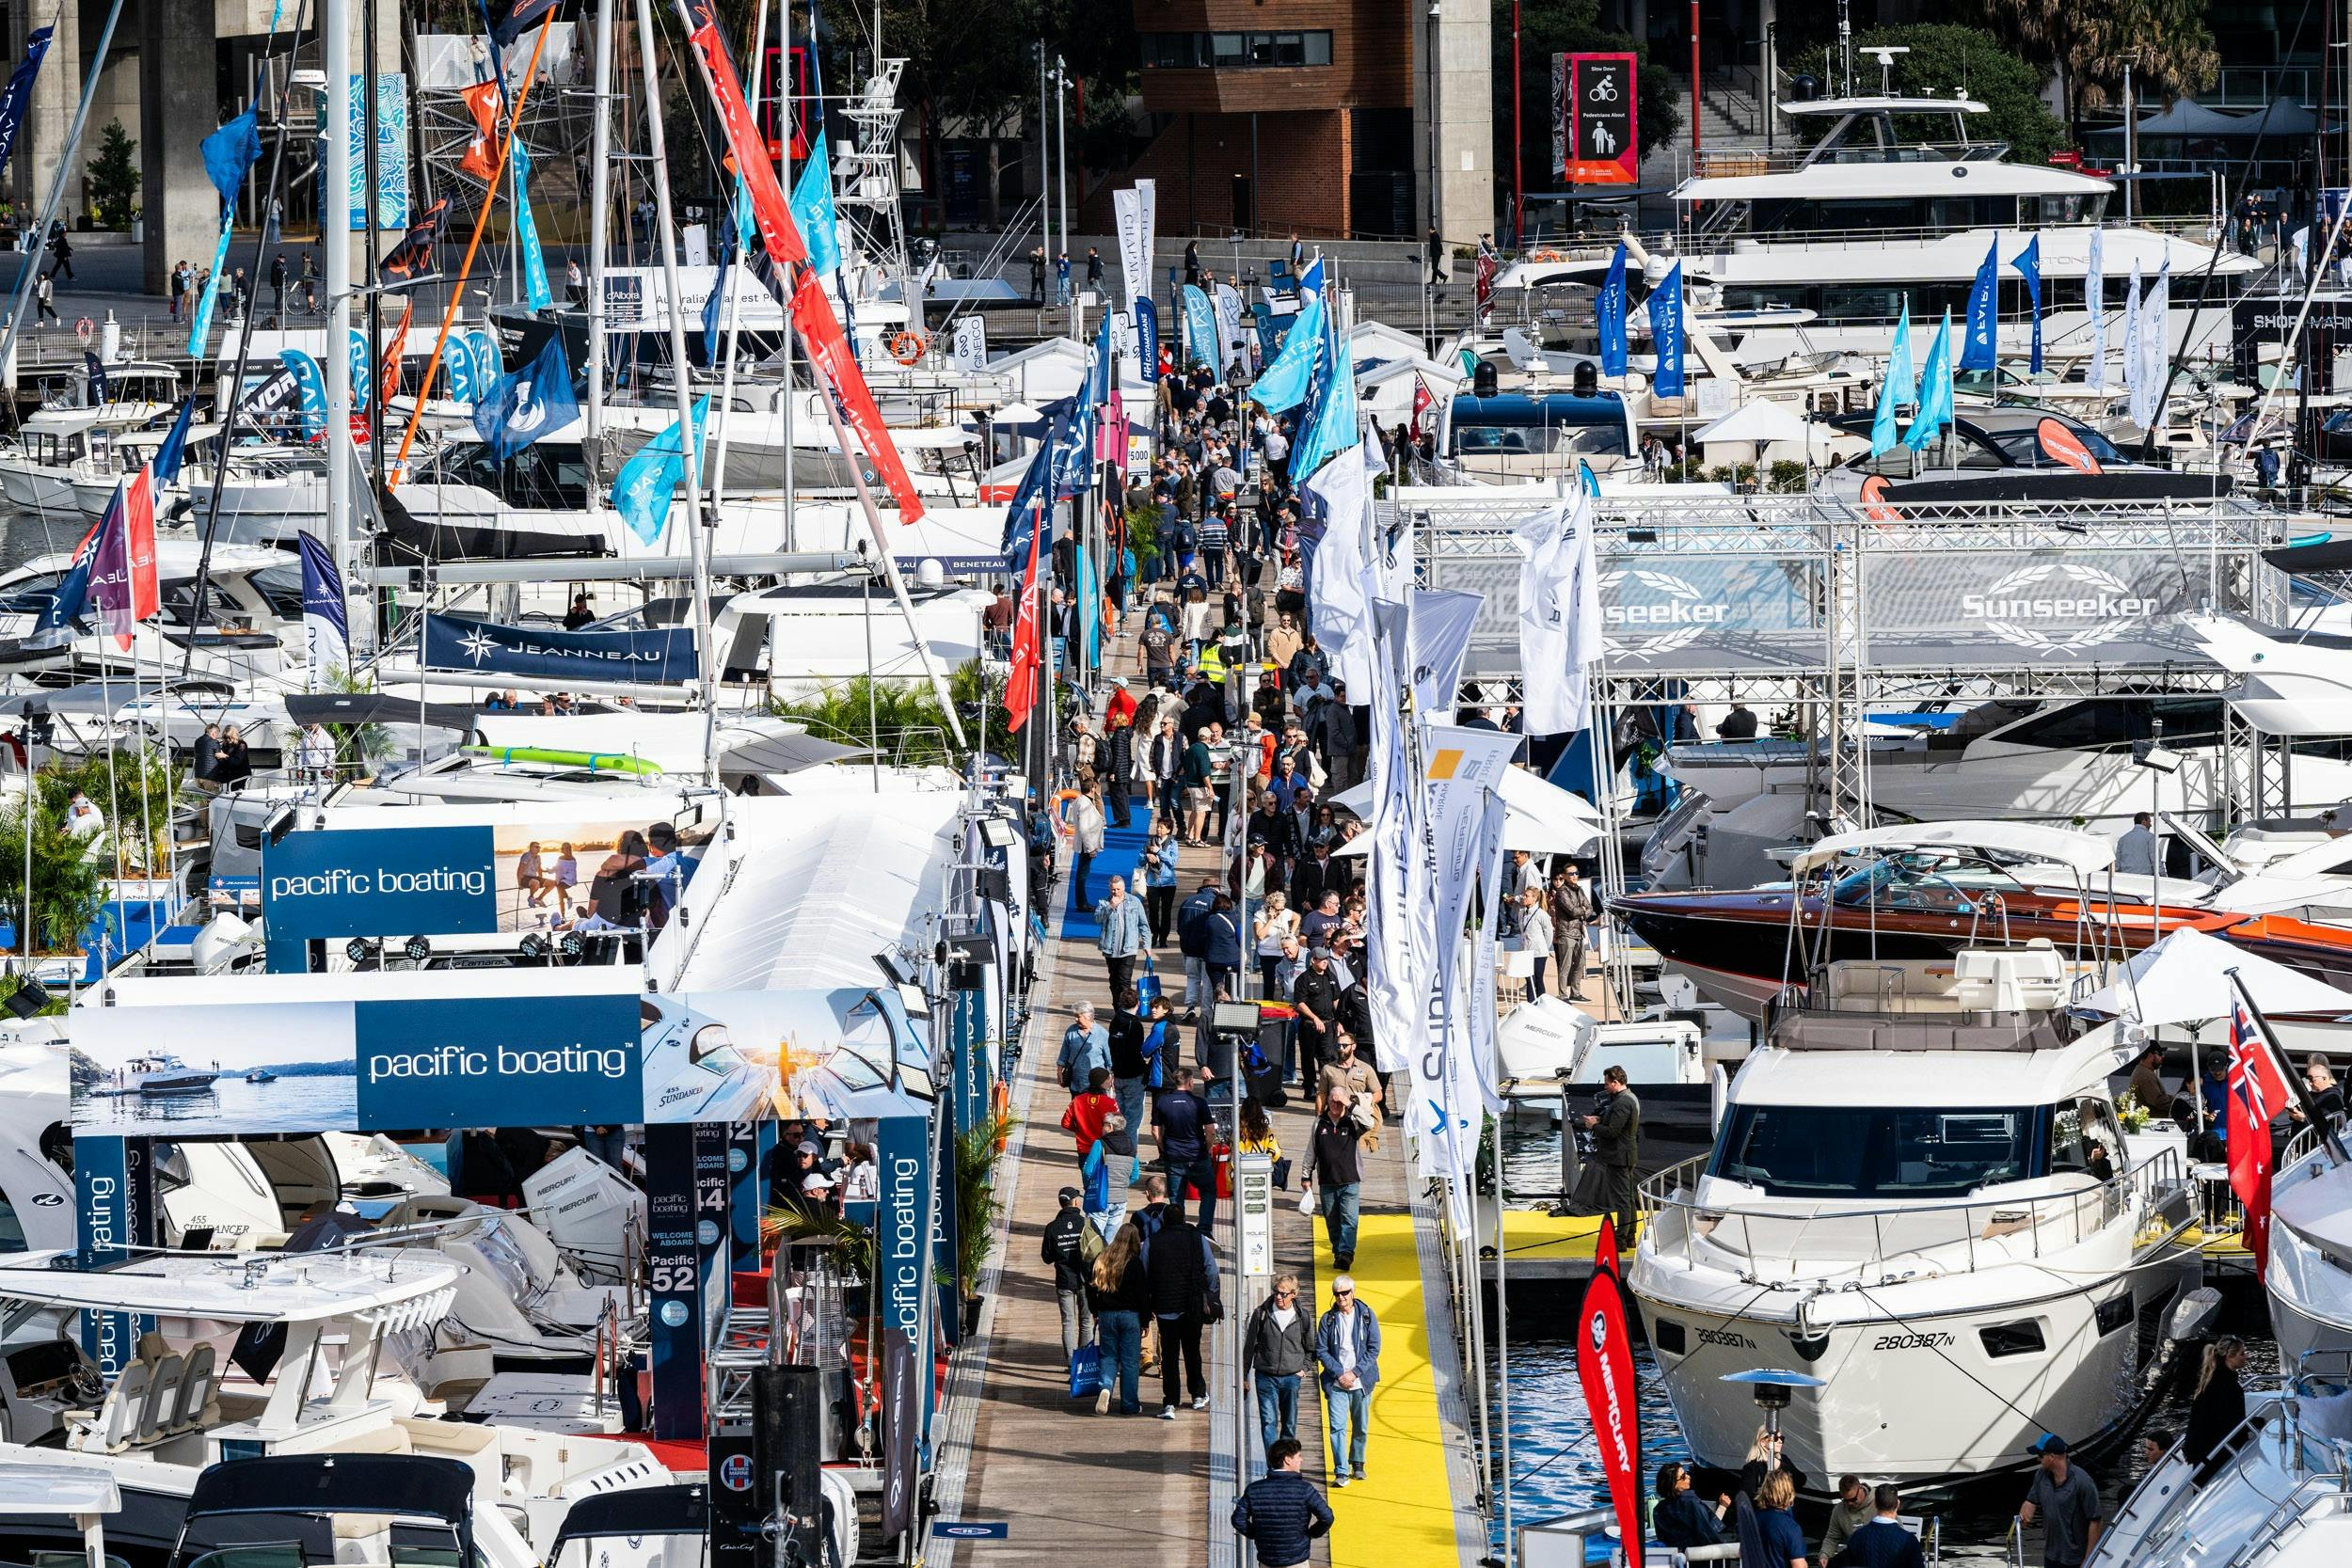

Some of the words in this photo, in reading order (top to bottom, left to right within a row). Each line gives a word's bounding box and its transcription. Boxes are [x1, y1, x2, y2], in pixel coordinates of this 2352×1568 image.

[972, 320, 984, 370] GINEICO
[1963, 594, 2157, 619] Sunseeker
[507, 641, 660, 661] JEANNEAU
[272, 869, 370, 901] pacific
[1524, 1023, 1564, 1039] MERCURY
[371, 1045, 487, 1084] pacific
[659, 1085, 704, 1107] SUNDANCER
[665, 1085, 679, 1094] 455
[537, 1173, 577, 1197] MERCURY
[559, 1192, 599, 1214] MERCURY
[653, 1194, 687, 1205] pacific
[190, 1215, 207, 1224] 455
[660, 1238, 694, 1246] ABOARD
[651, 1255, 695, 1266] Pacific
[652, 1266, 695, 1292] 52
[1599, 1352, 1631, 1473] MERCURY
